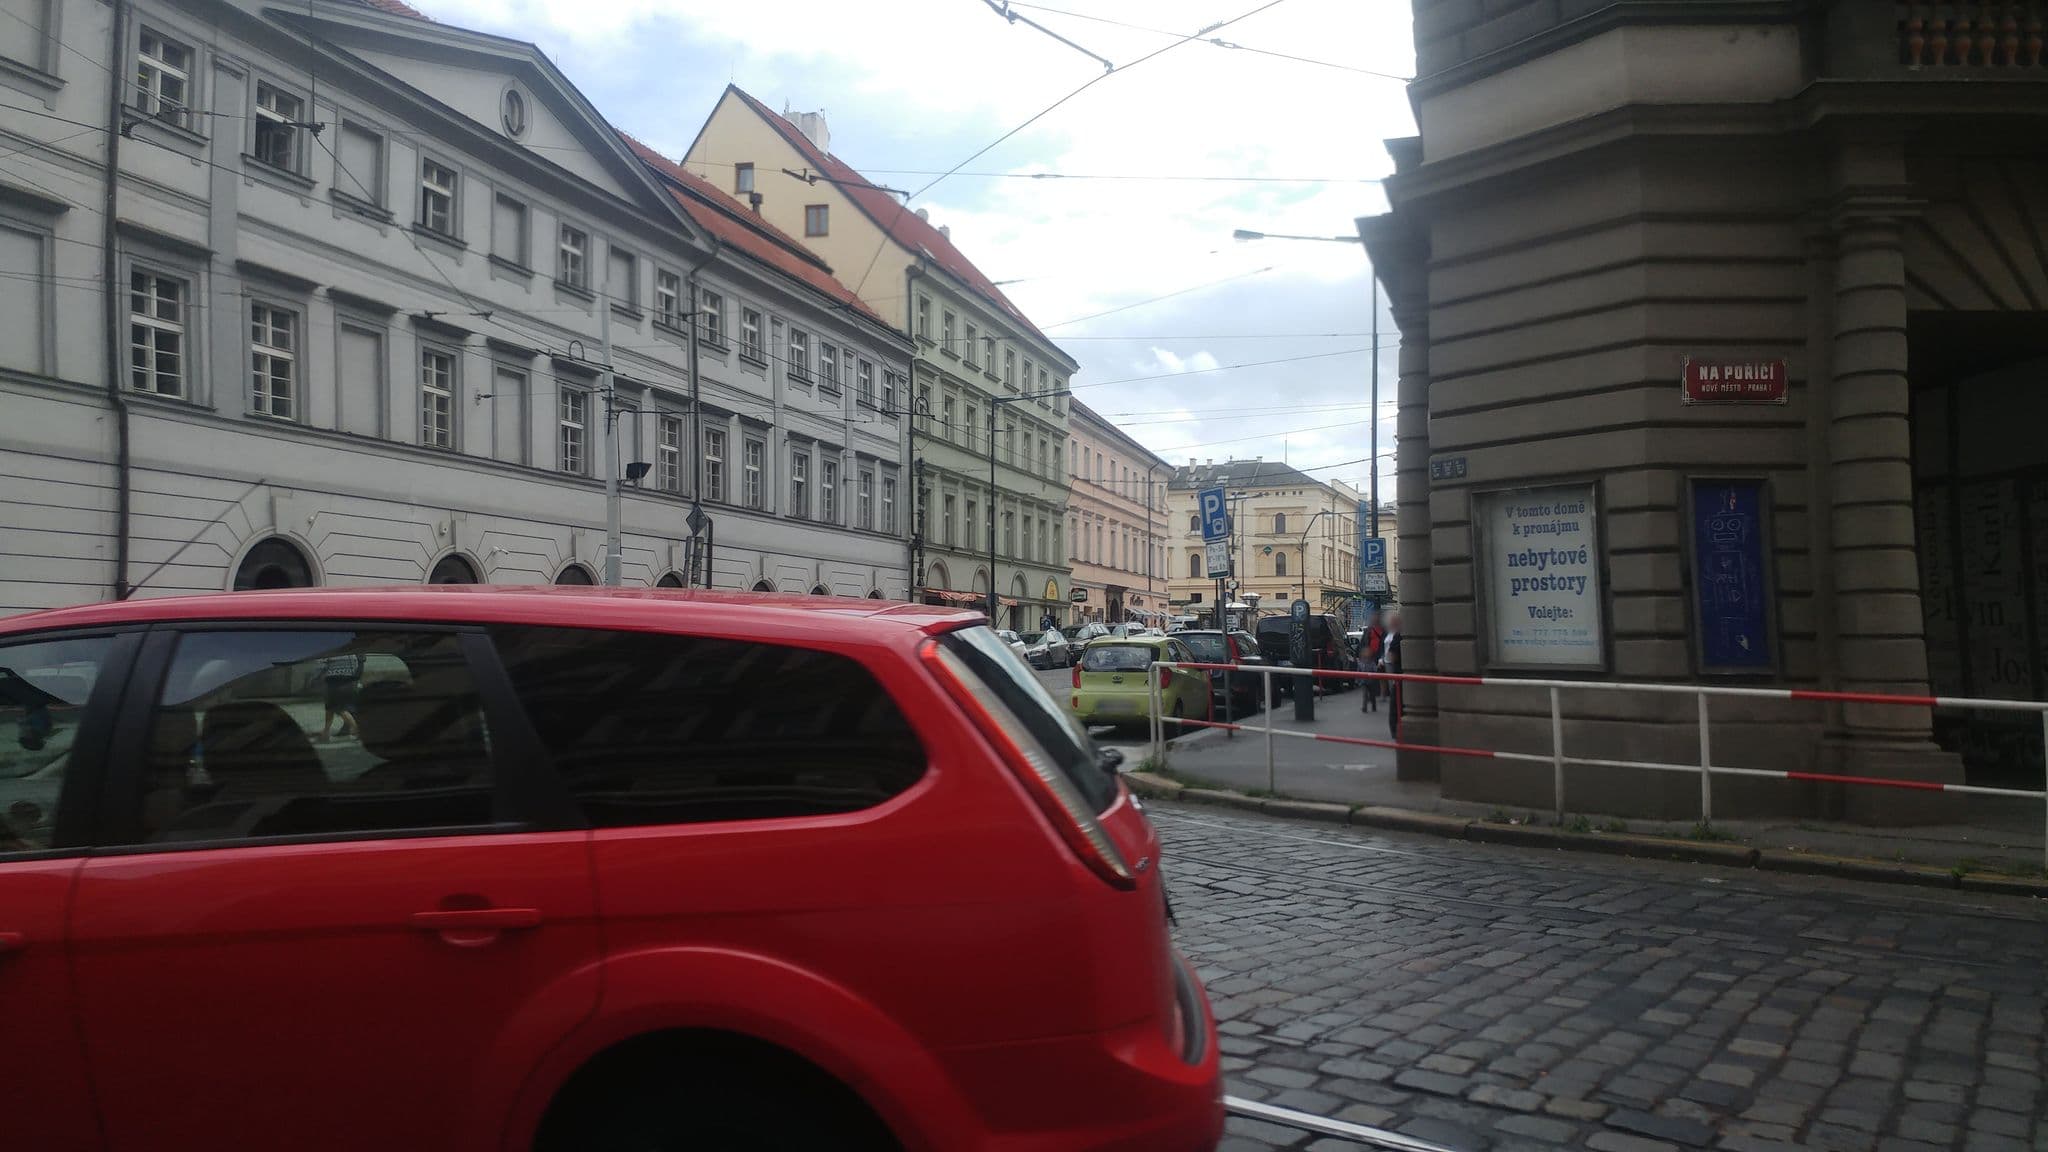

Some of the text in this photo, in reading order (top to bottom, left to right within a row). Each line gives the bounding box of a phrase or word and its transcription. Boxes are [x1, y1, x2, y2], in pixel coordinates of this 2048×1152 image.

[1699, 366, 1719, 380] NA
[1702, 383, 1718, 393] NOVÉ
[1747, 383, 1767, 392] PRAHA
[1204, 494, 1220, 525] P
[1506, 501, 1585, 518] V tomto domě
[1512, 520, 1580, 537] k pronájmu
[1508, 545, 1587, 571] nebytové
[1511, 574, 1587, 596] prostory
[1528, 606, 1573, 621] Volejte:
